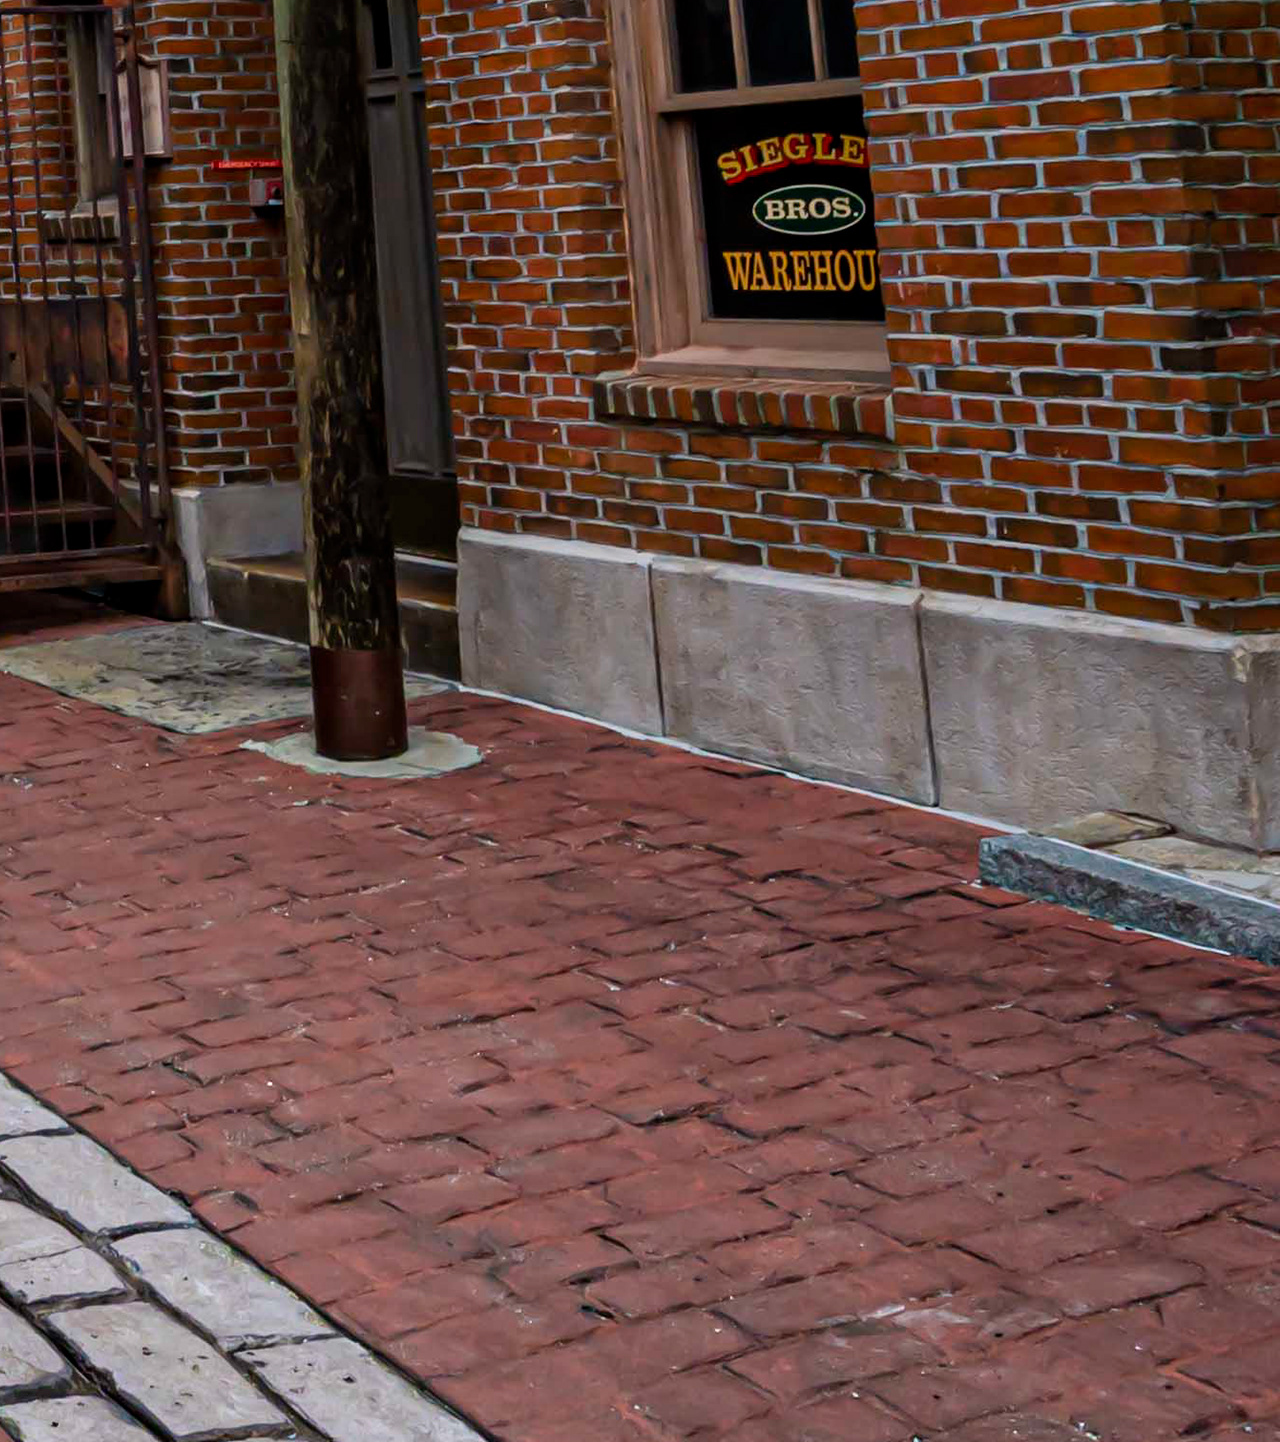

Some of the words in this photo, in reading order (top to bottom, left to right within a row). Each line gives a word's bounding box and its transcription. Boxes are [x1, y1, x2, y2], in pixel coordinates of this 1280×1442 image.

[716, 132, 868, 184] SIEGLE
[763, 197, 860, 221] BROS.
[722, 250, 877, 292] WAREHOU
